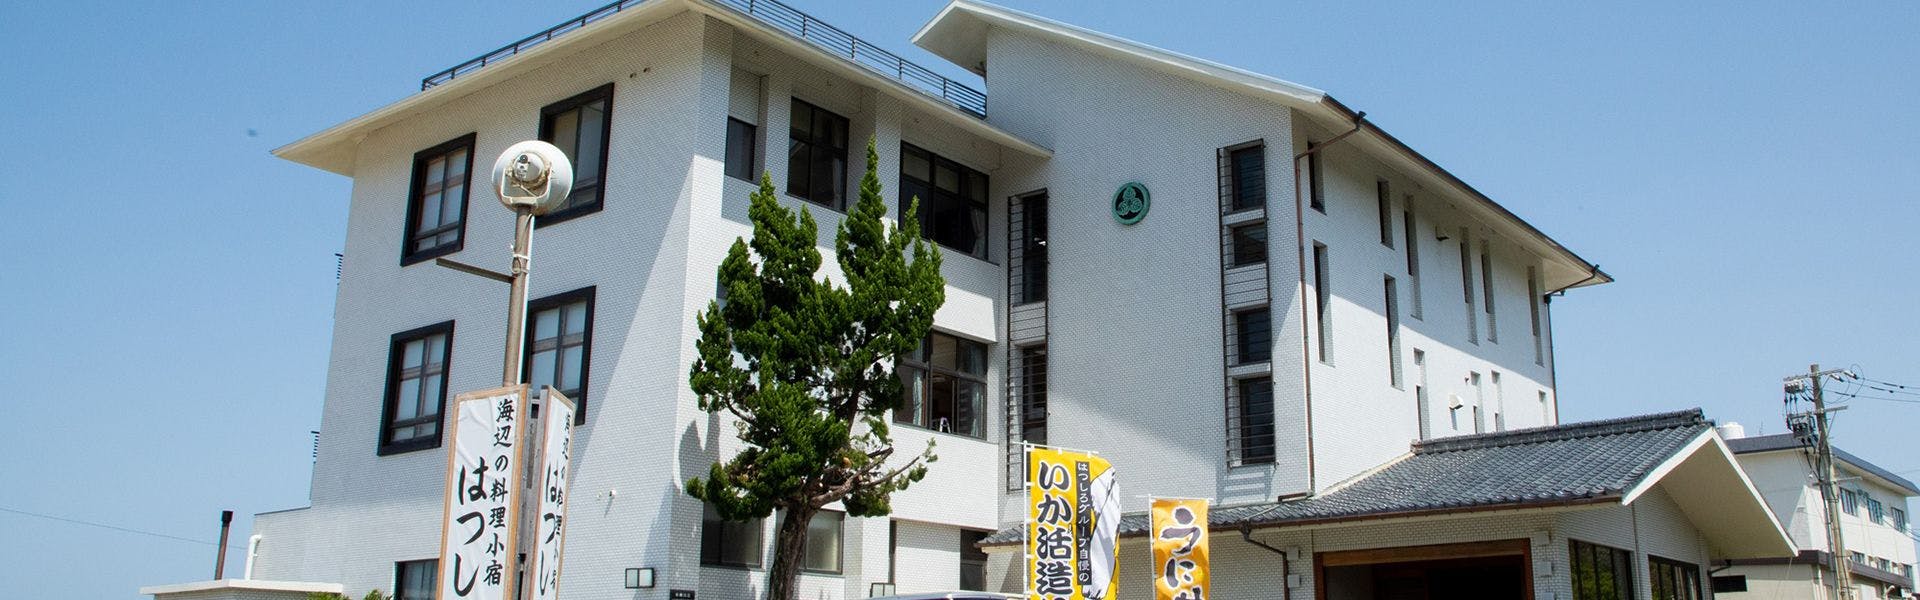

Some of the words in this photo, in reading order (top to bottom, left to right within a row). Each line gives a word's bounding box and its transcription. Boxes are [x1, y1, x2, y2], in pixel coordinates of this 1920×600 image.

[454, 456, 489, 597] はつし
[483, 398, 514, 587] 海辺の料理小宿
[1035, 460, 1074, 600] いか活造
[1077, 462, 1090, 582] はつしろグループ自慢の
